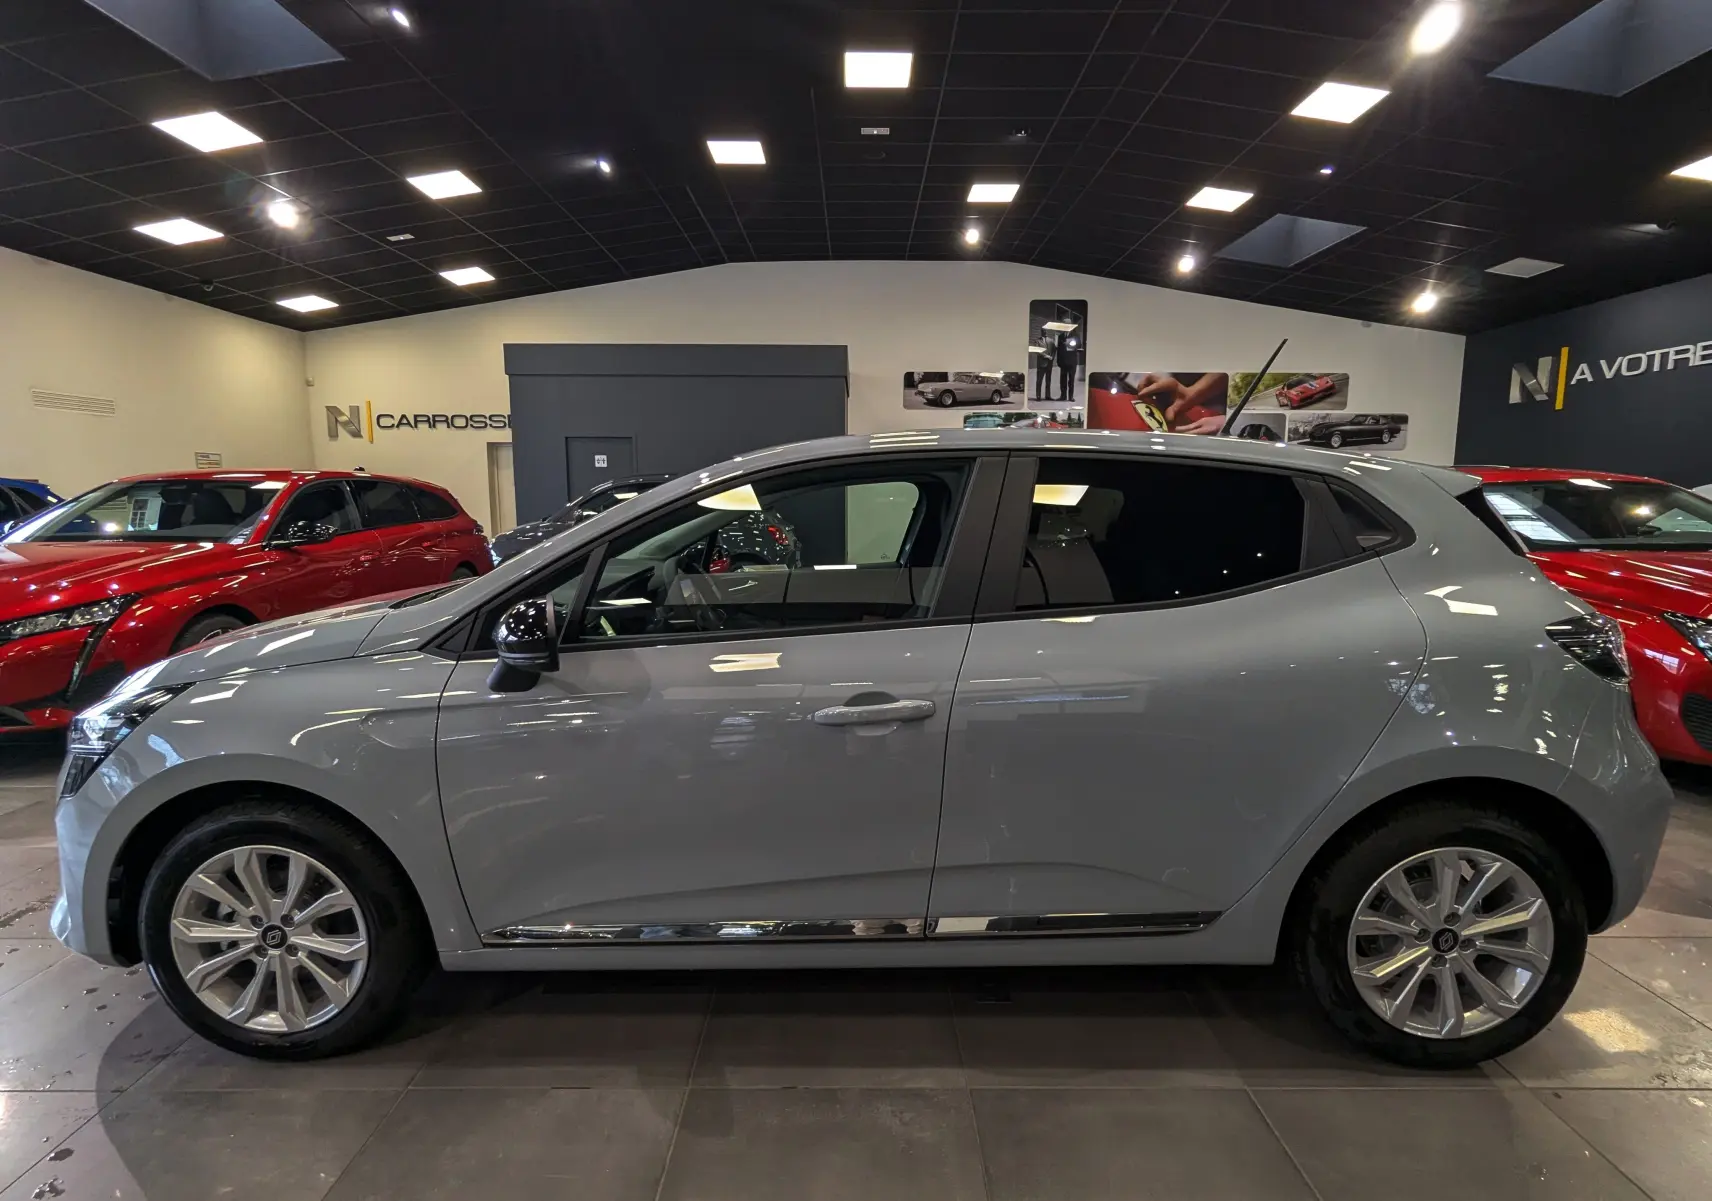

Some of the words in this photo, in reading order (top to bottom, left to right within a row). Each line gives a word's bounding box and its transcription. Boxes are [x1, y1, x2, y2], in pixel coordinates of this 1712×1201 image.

[1570, 363, 1594, 385] A
[1599, 340, 1712, 379] VOTRE
[376, 413, 512, 430] CARROSS
